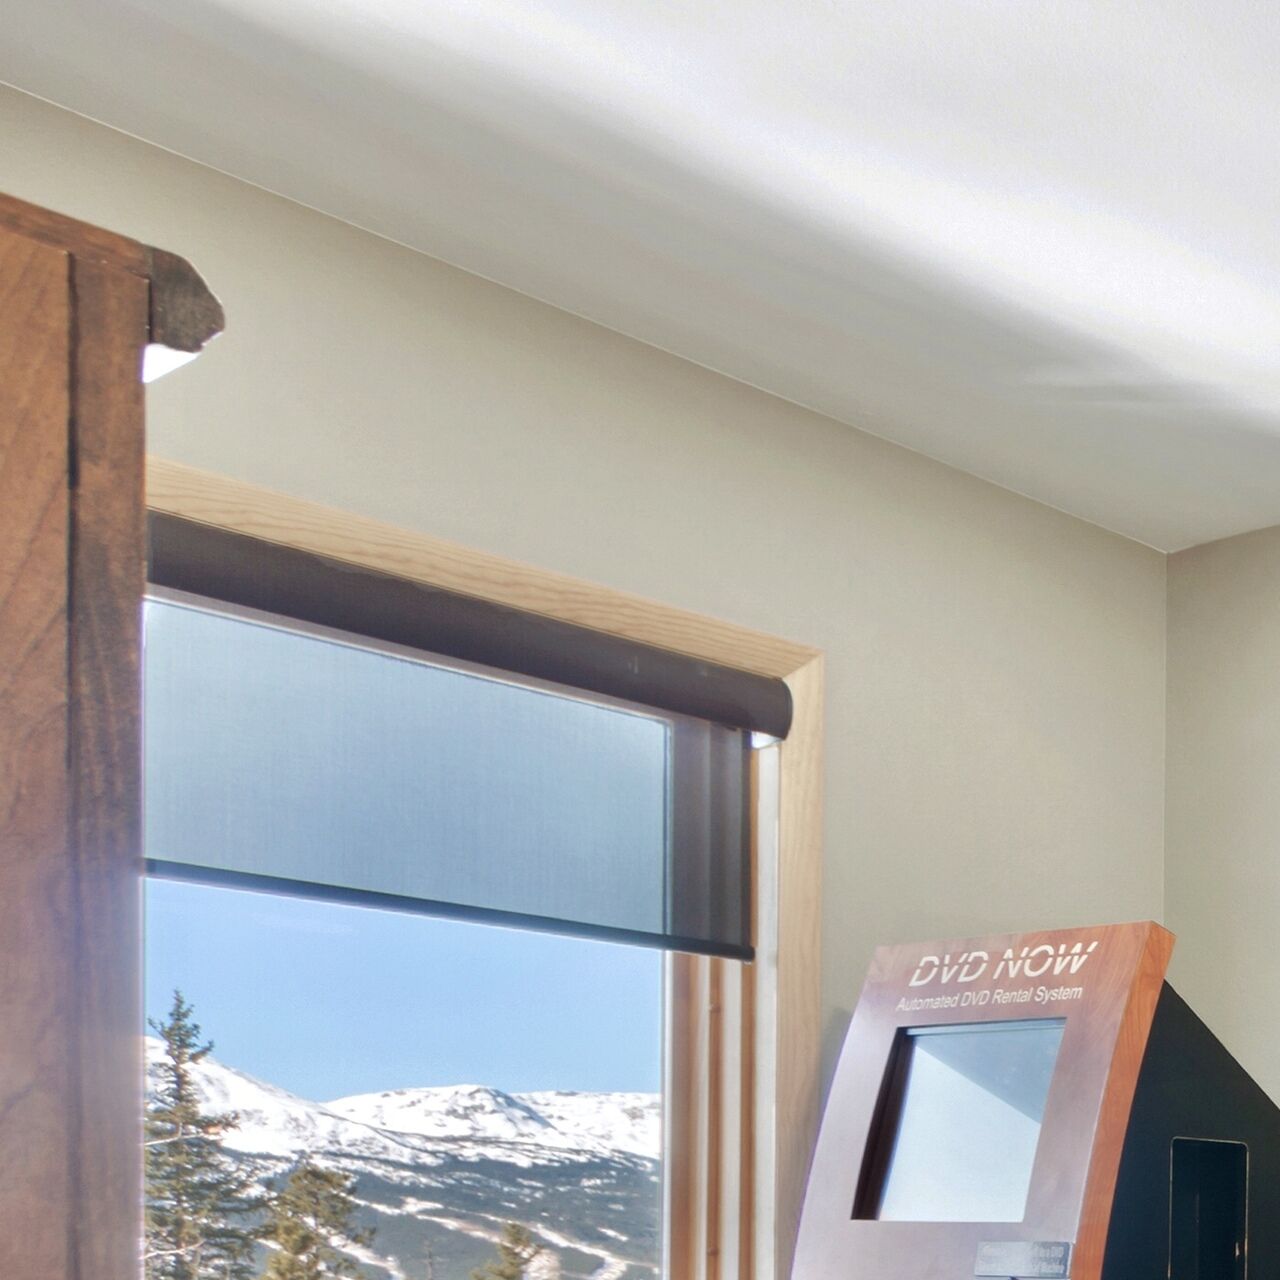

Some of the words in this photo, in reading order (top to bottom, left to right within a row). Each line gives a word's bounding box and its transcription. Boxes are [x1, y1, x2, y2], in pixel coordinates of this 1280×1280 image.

[908, 950, 988, 987] DVD
[993, 941, 1098, 980] NOW
[896, 990, 959, 1012] Automated
[960, 990, 990, 1007] DVD
[992, 986, 1032, 1005] Rental
[1034, 985, 1083, 1005] System
